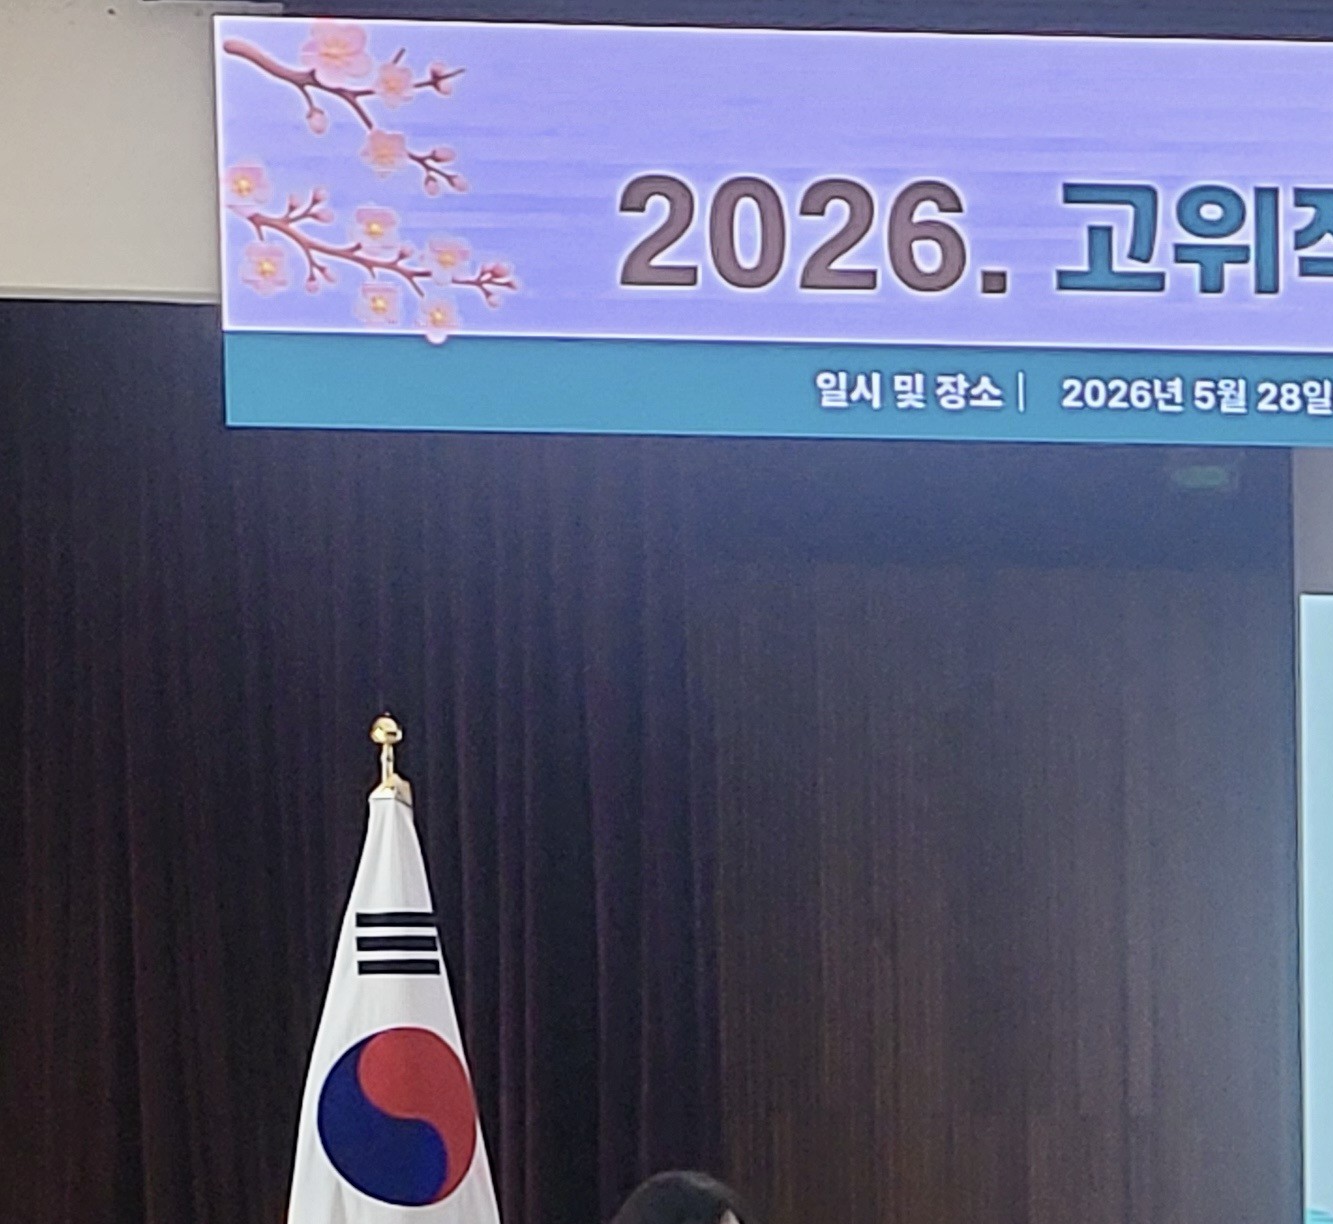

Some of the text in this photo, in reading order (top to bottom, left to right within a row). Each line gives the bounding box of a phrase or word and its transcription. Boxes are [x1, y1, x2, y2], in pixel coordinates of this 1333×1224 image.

[619, 174, 1007, 294] 2026.
[816, 371, 1003, 410] 일시 및 장소
[1062, 377, 1184, 412] 2026년
[1194, 378, 1247, 413] 5월
